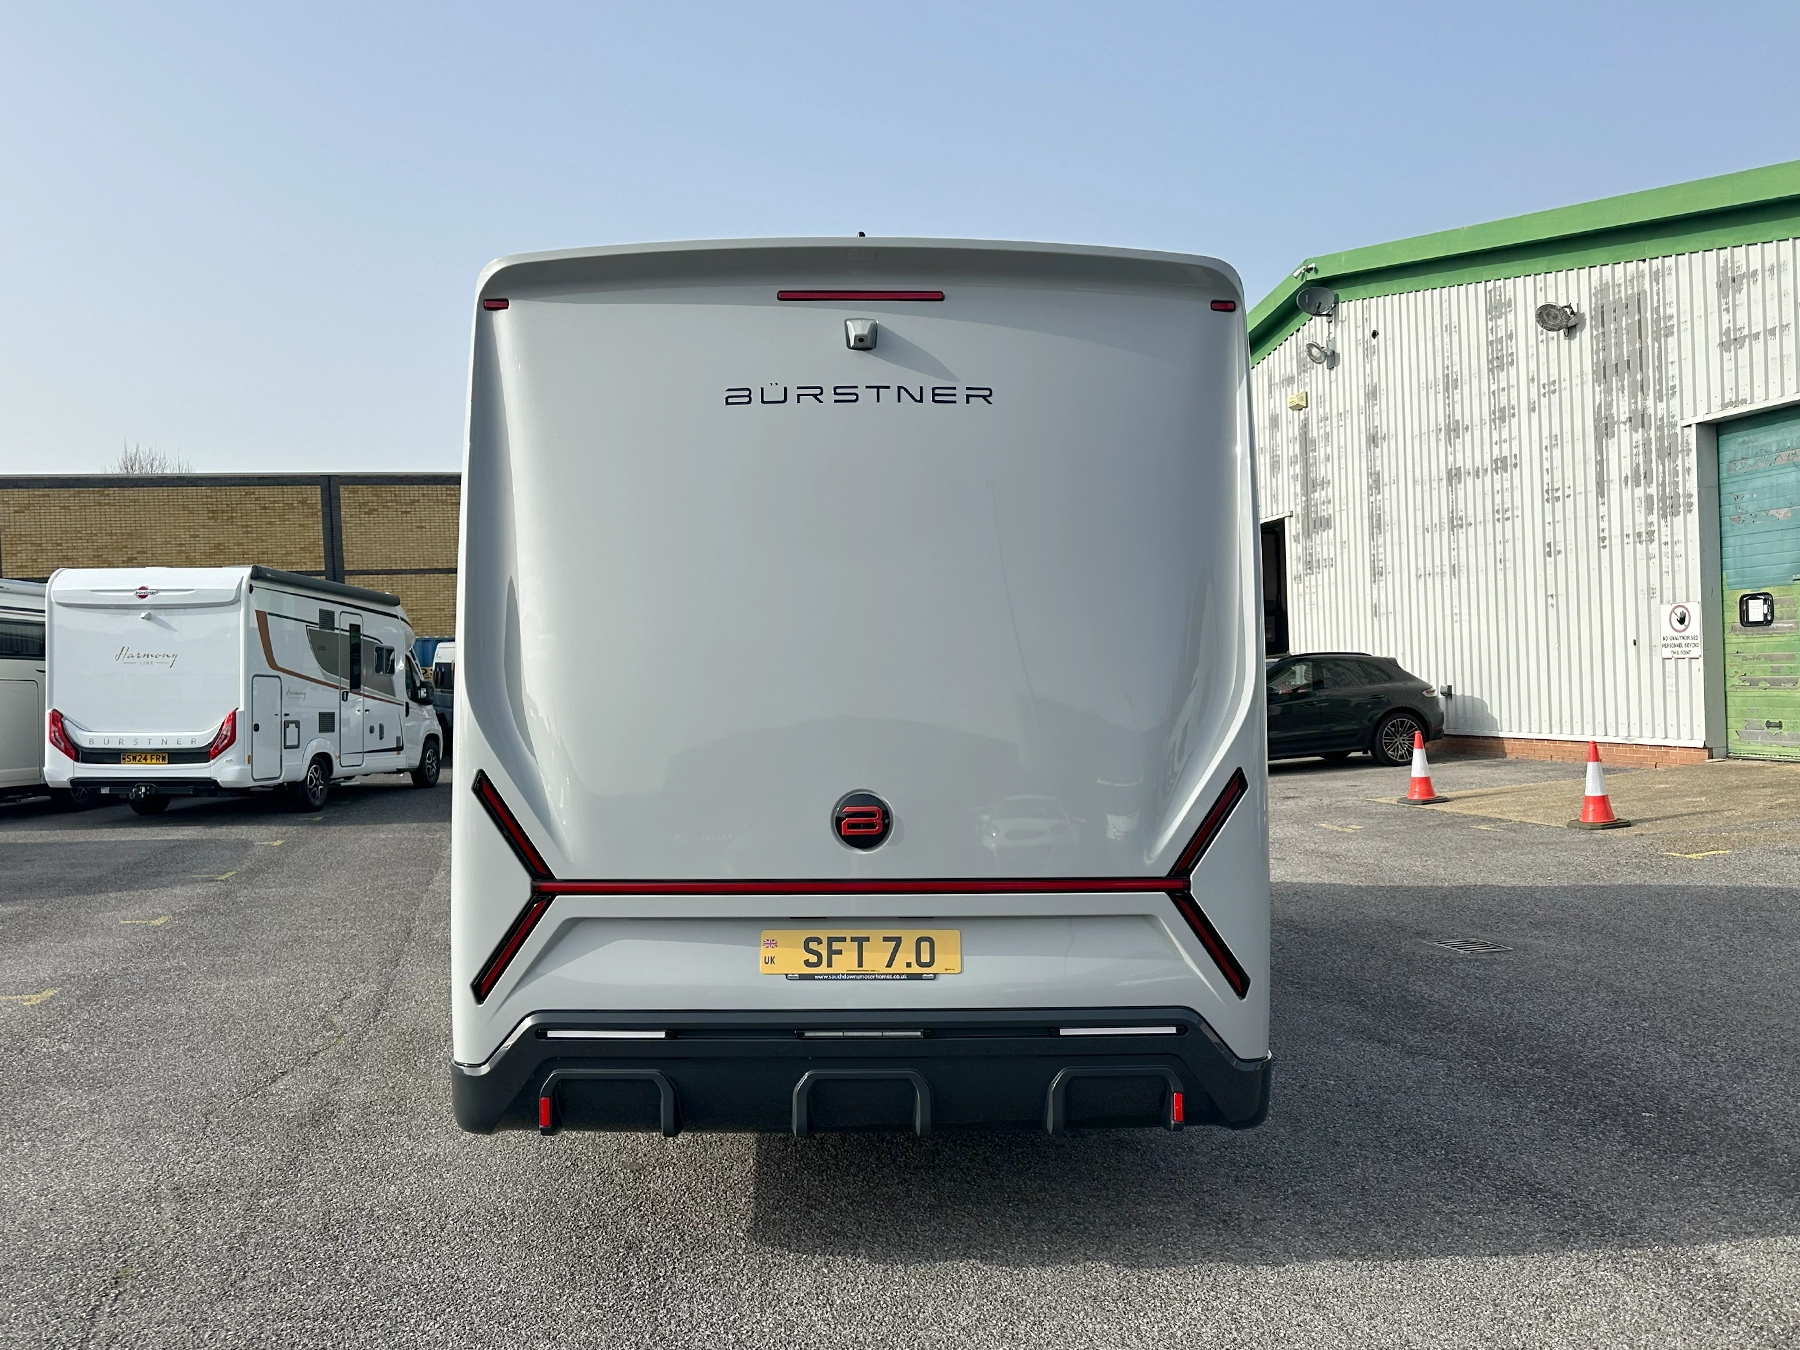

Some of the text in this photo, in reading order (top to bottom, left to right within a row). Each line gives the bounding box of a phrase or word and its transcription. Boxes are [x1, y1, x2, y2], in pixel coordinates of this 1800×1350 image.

[724, 382, 993, 406] BÜRSTNER
[115, 646, 178, 668] Harmony
[126, 754, 167, 763] SW24 FRW
[764, 956, 775, 965] UK
[803, 936, 936, 968] SFT 7.0
